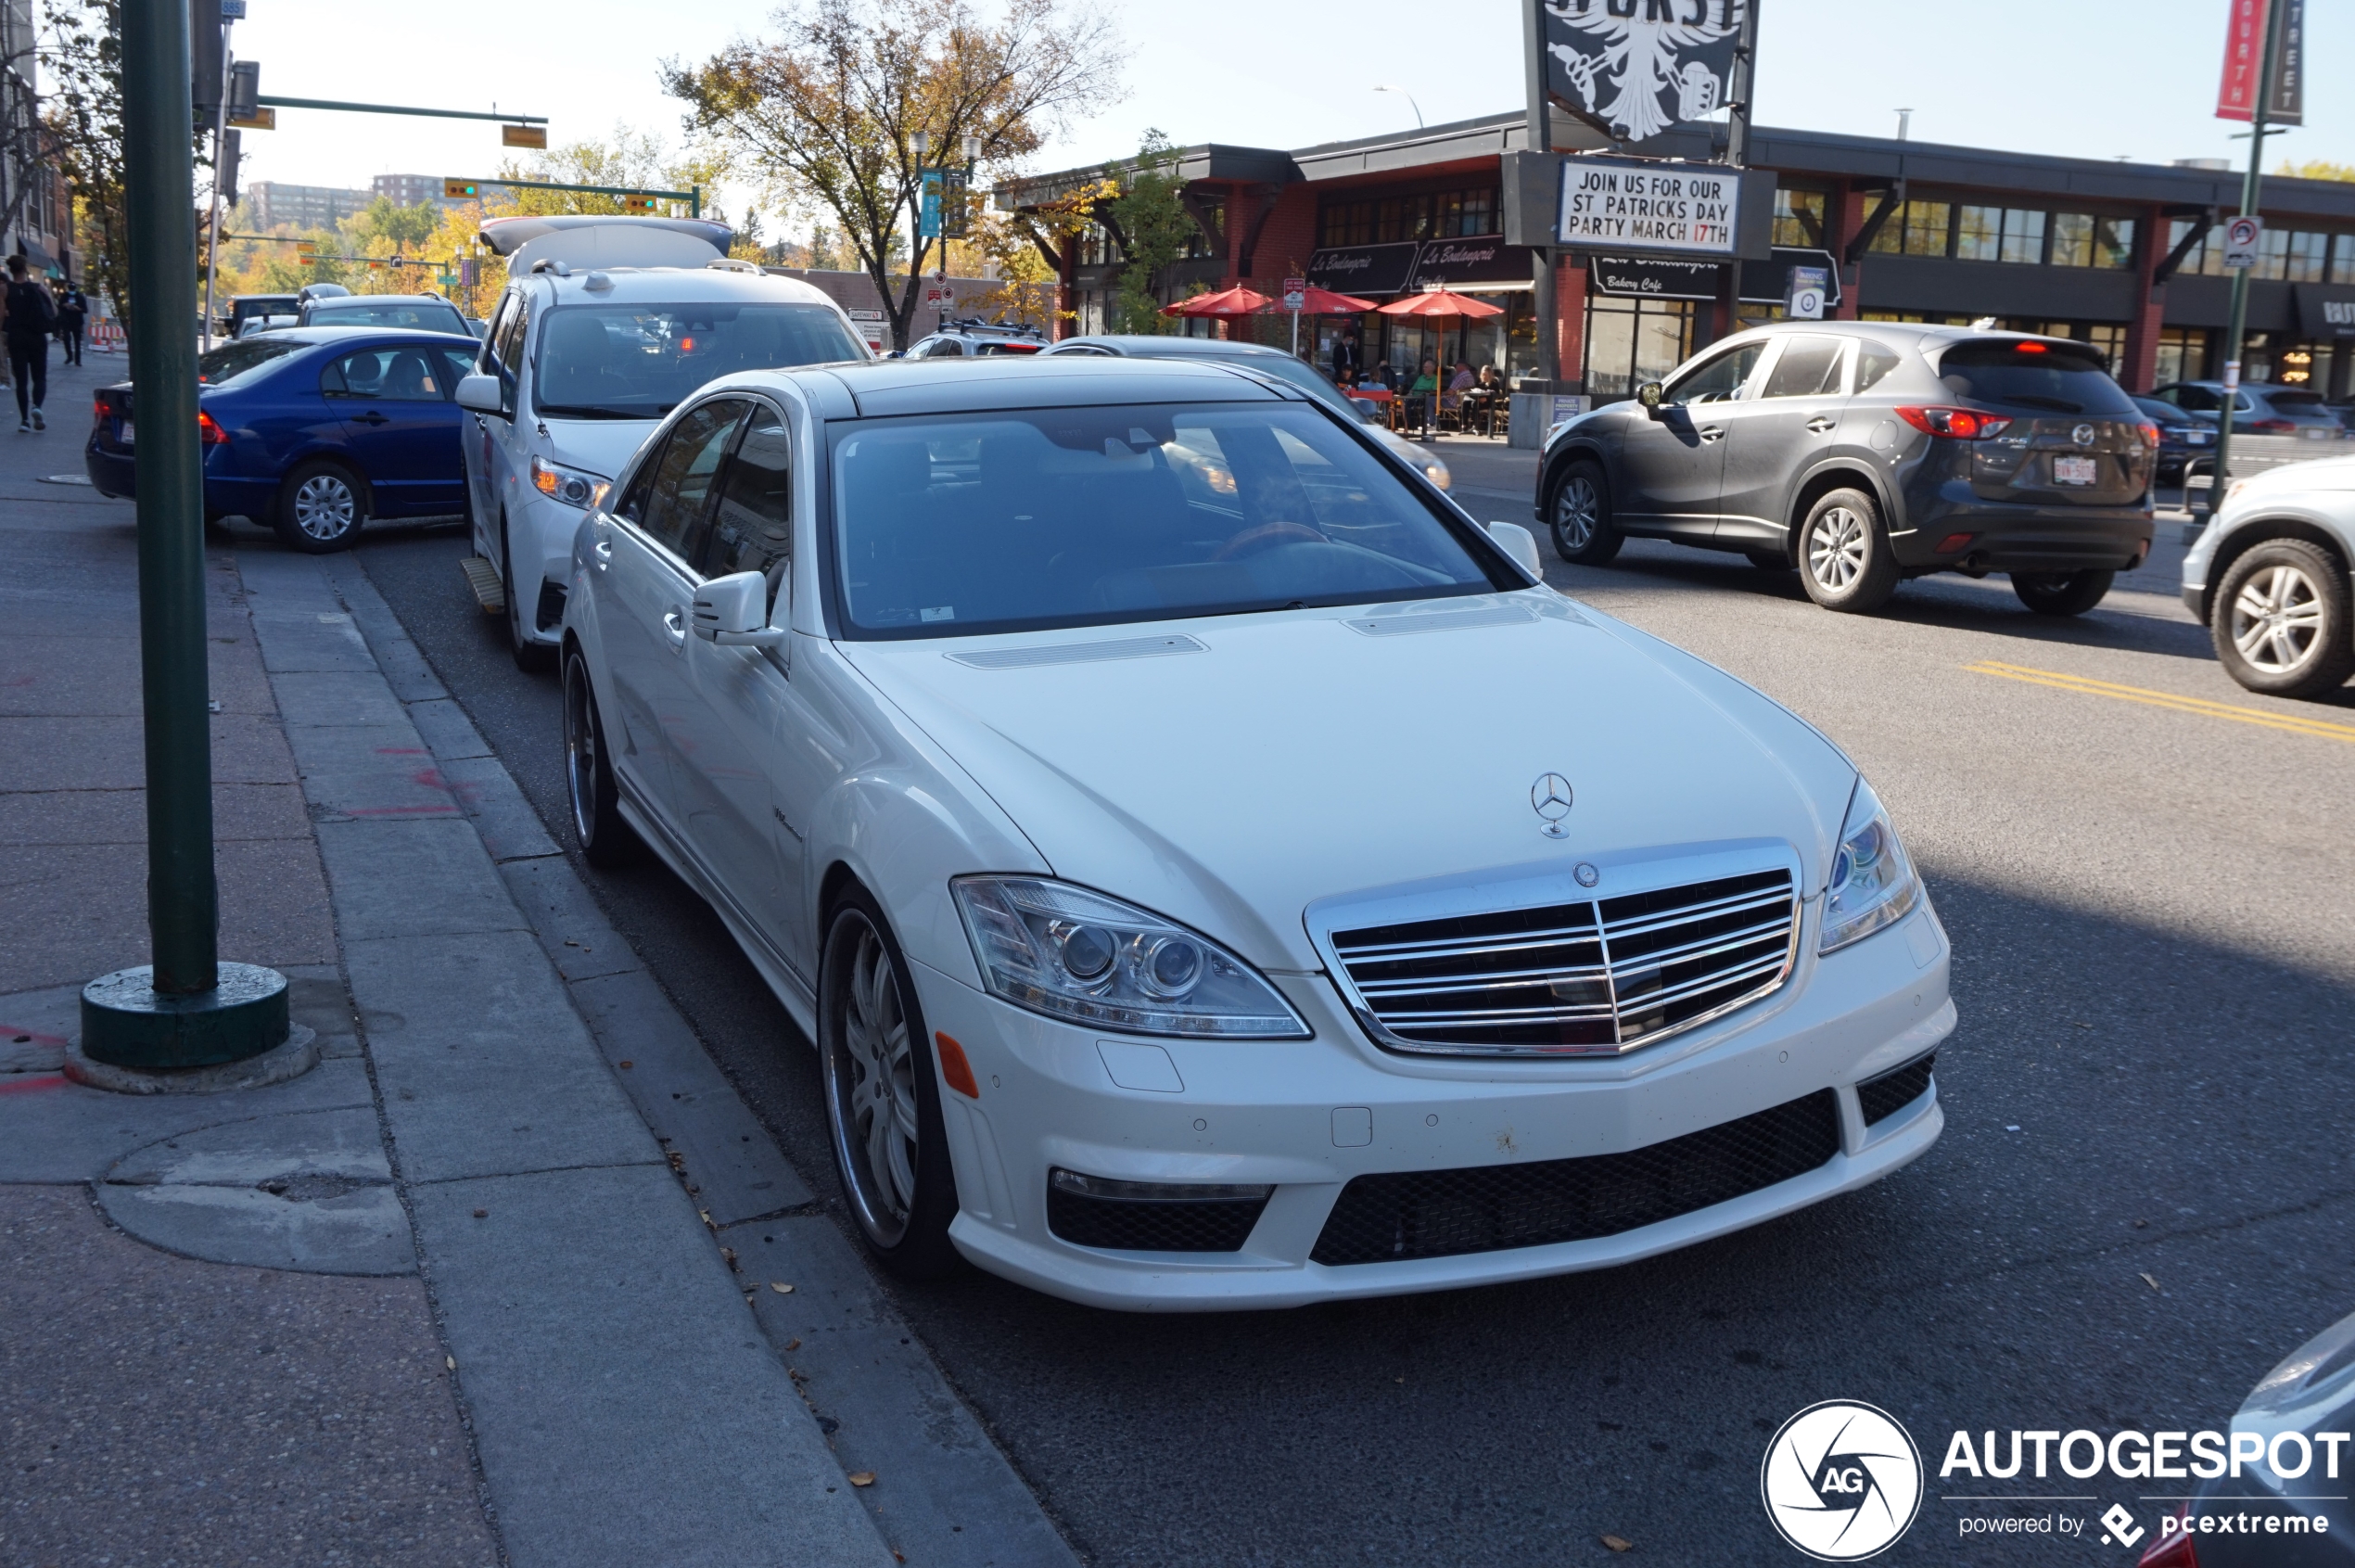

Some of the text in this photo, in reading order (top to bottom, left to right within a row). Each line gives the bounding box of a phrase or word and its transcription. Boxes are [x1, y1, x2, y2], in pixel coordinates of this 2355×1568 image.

[2282, 0, 2301, 108] TREET
[1579, 172, 1721, 199] JOIN US FOR OUR
[1573, 194, 1728, 222] ST PATRICKS DAY
[1570, 215, 1728, 244] PARTY MARCH 17TH
[1310, 253, 1371, 274] La Boulangerie
[1422, 245, 1496, 267] La Boulangerie
[1607, 275, 1662, 292] Bakery Cafe
[1799, 272, 1823, 280] PARKING
